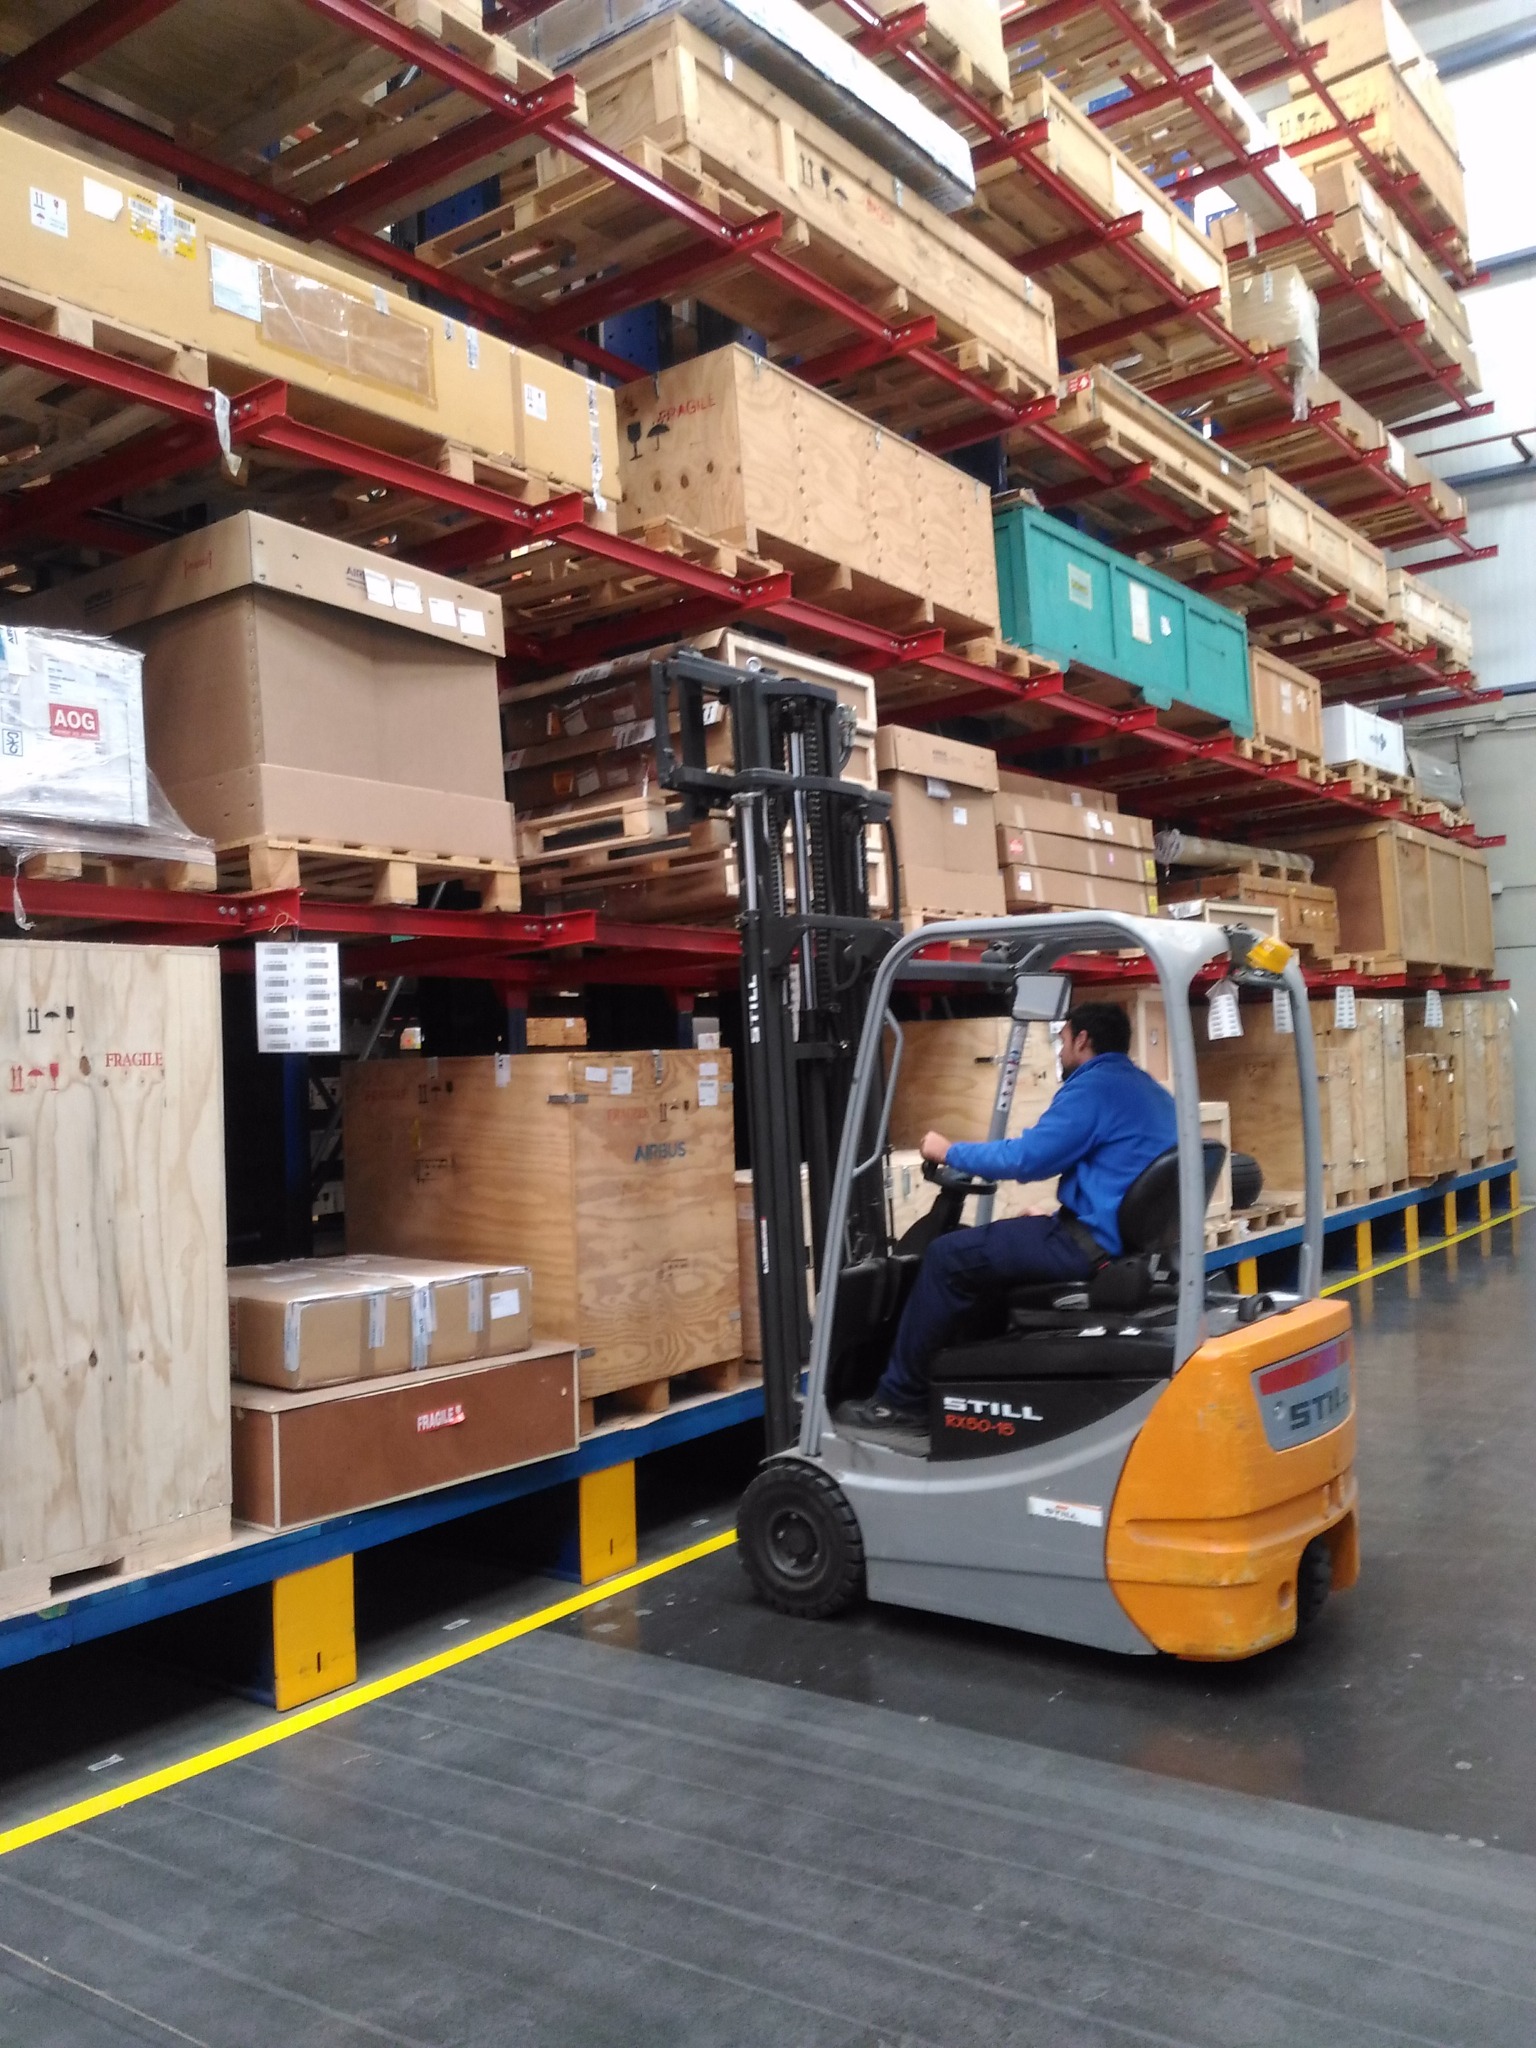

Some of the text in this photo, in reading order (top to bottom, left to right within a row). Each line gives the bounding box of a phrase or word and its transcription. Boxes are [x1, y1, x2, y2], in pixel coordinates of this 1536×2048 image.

[54, 709, 96, 731] AOG
[747, 974, 760, 1044] STILL
[105, 1052, 164, 1068] FRAGILE
[634, 1141, 686, 1162] AIRBUS
[416, 1406, 454, 1432] FRAGILE
[943, 1396, 1044, 1421] STILL
